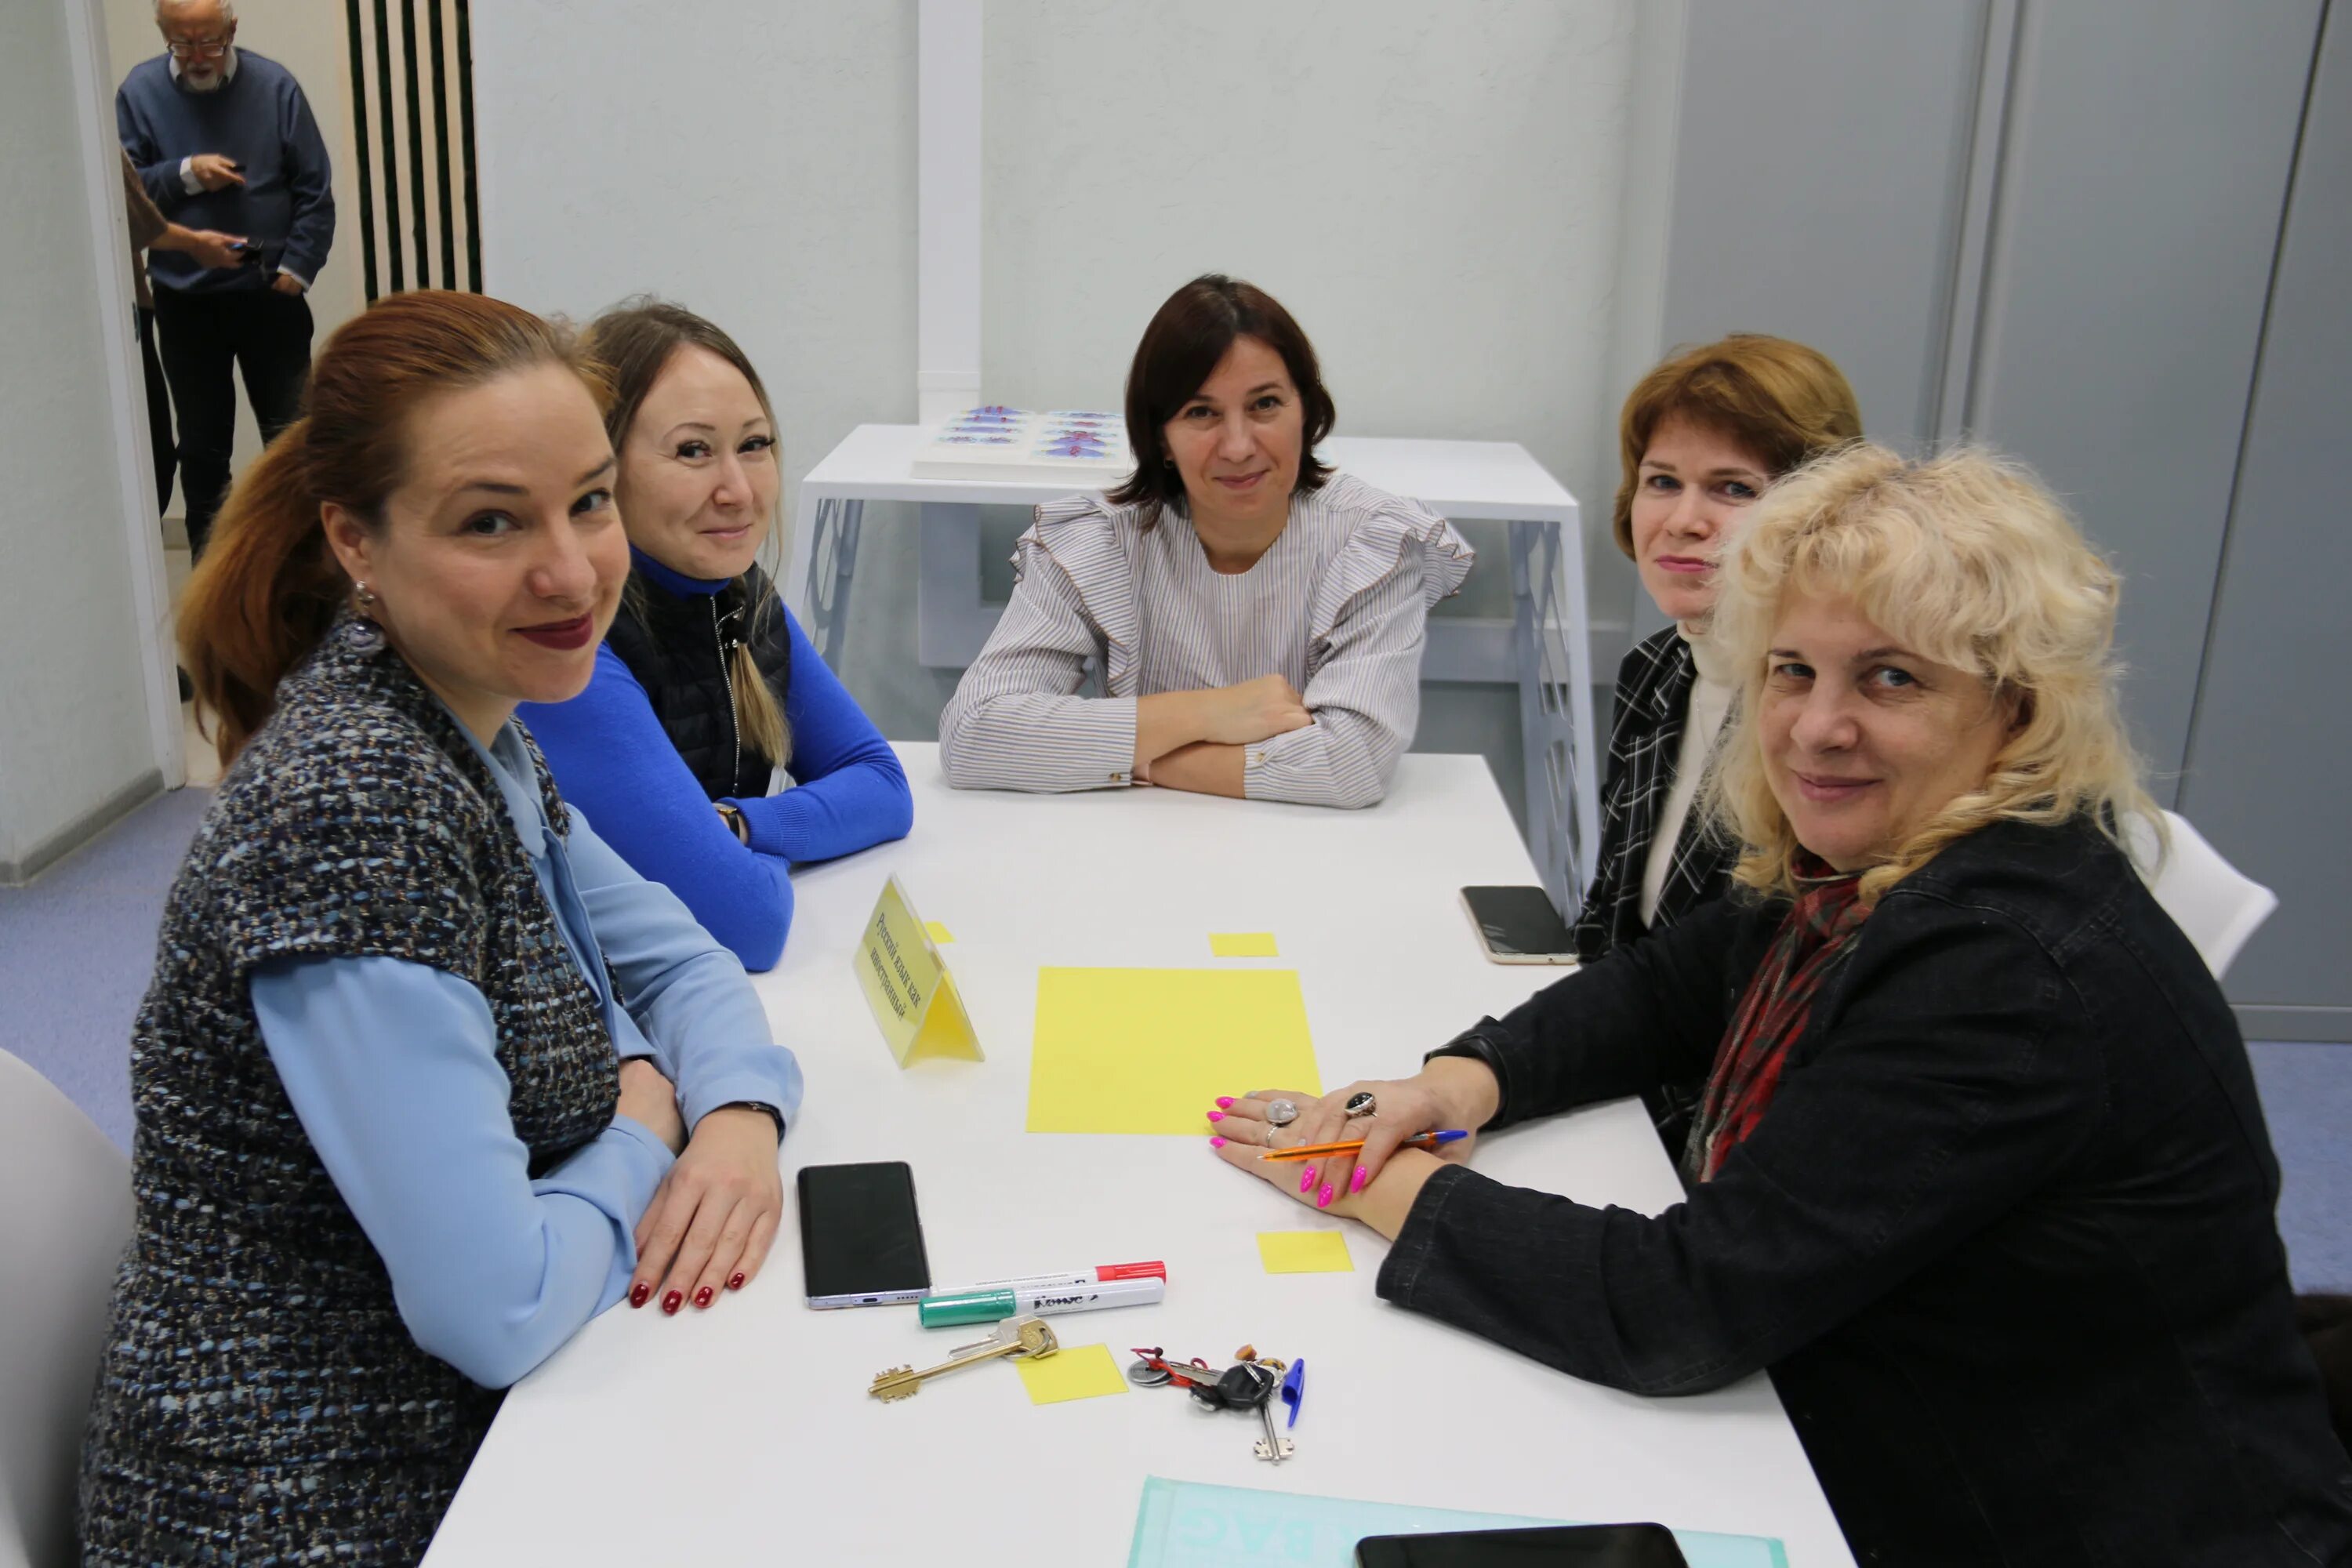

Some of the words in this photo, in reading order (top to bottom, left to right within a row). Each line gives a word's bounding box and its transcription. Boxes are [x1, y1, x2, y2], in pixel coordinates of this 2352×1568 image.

[870, 946, 907, 1022] иностранный
[876, 912, 899, 960] Русский
[894, 955, 910, 988] язык
[907, 981, 921, 1010] как
[1178, 1507, 1316, 1561] BAG
